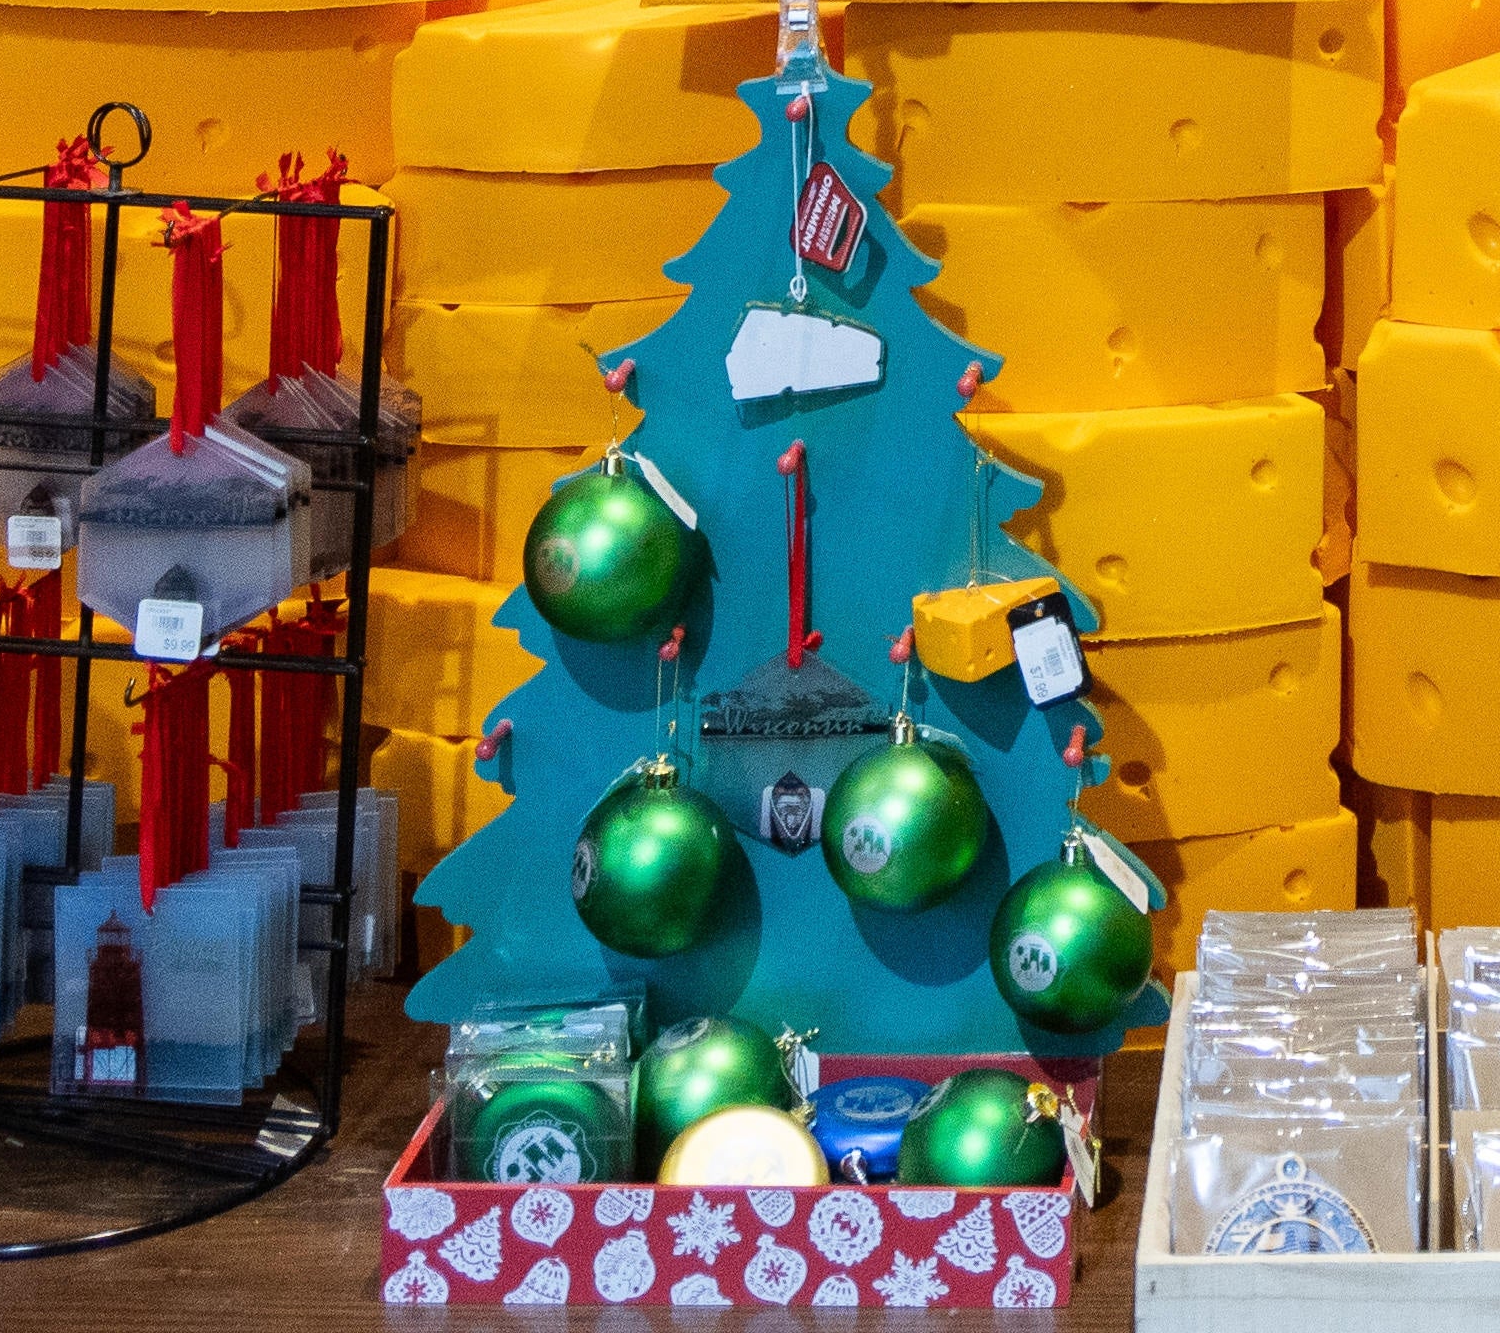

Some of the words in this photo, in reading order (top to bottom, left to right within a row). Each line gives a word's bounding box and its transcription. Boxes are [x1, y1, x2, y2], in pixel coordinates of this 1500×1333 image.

[801, 174, 834, 253] ORNAMENT
[163, 637, 196, 653] $9.99
[1029, 665, 1049, 699] $7.99
[723, 706, 864, 735] Wisconsin
